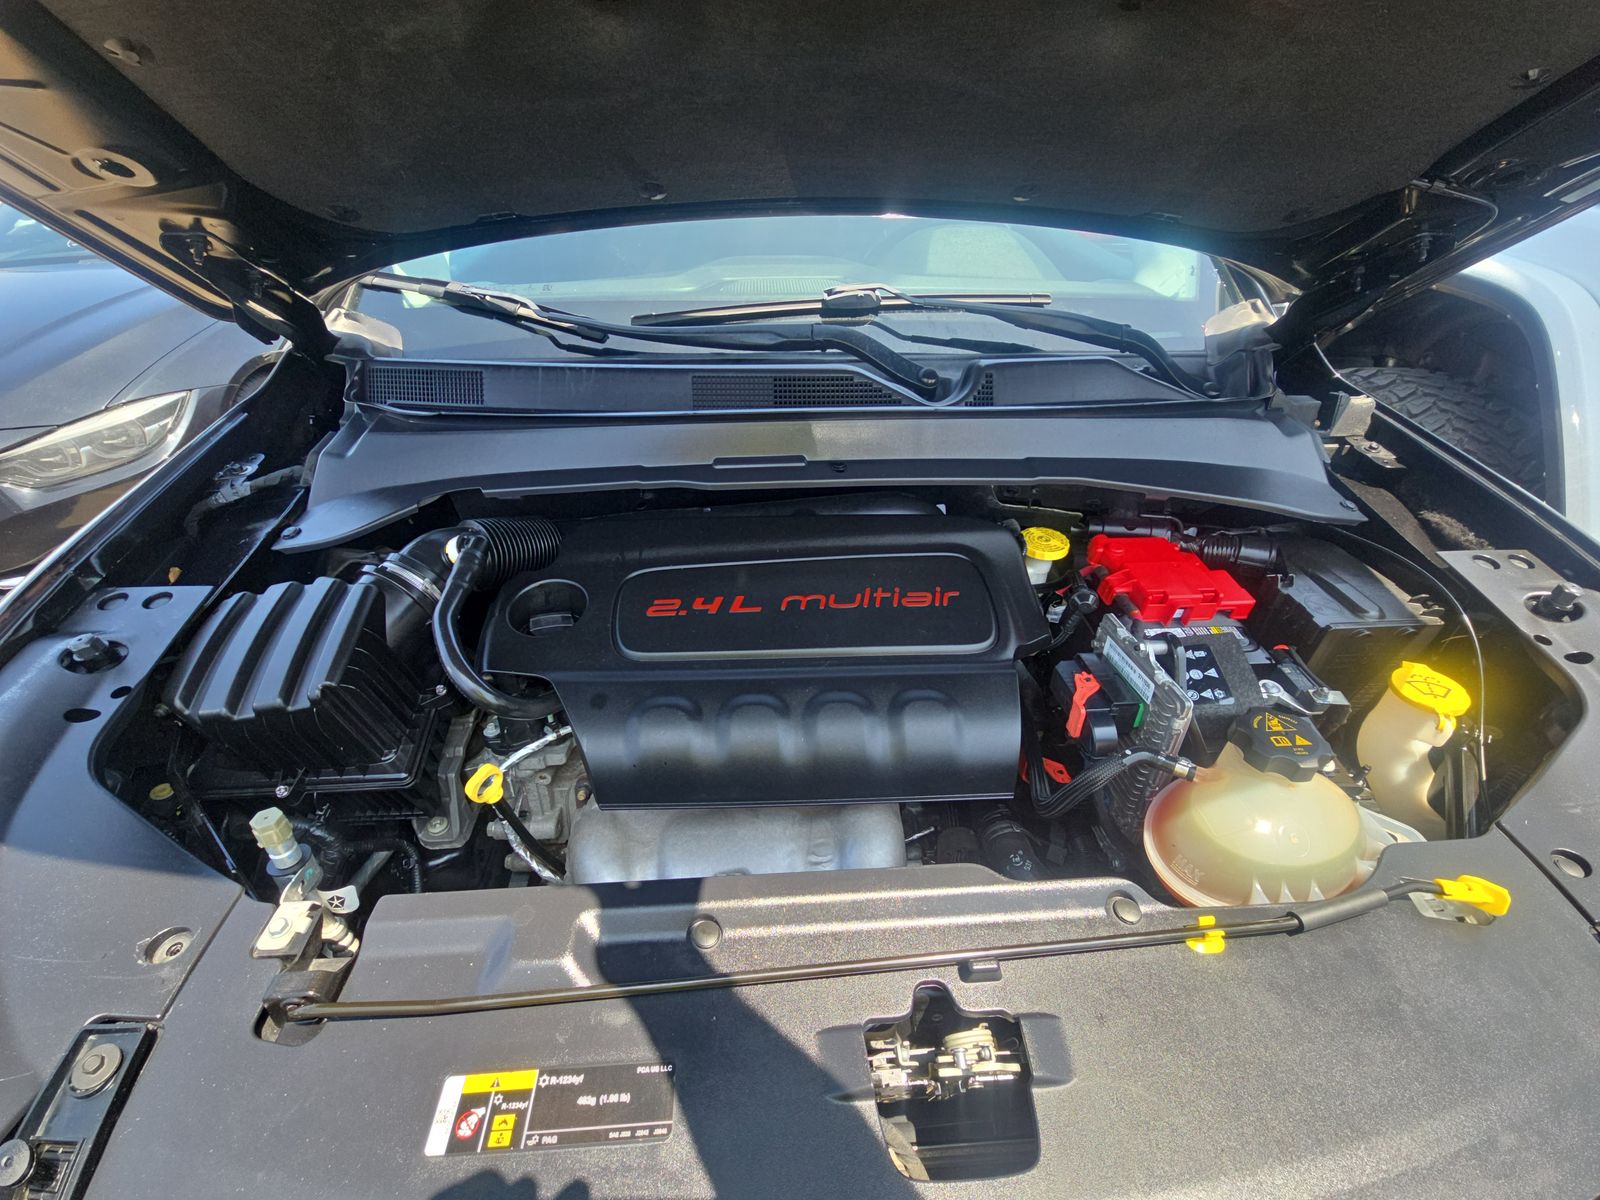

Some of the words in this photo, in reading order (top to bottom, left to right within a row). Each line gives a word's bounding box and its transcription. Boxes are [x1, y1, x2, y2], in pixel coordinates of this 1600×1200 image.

[780, 586, 960, 611] multiair
[660, 1064, 673, 1072] LLC
[550, 1074, 585, 1086] R-1234yf
[501, 1101, 529, 1110] R-1234yf
